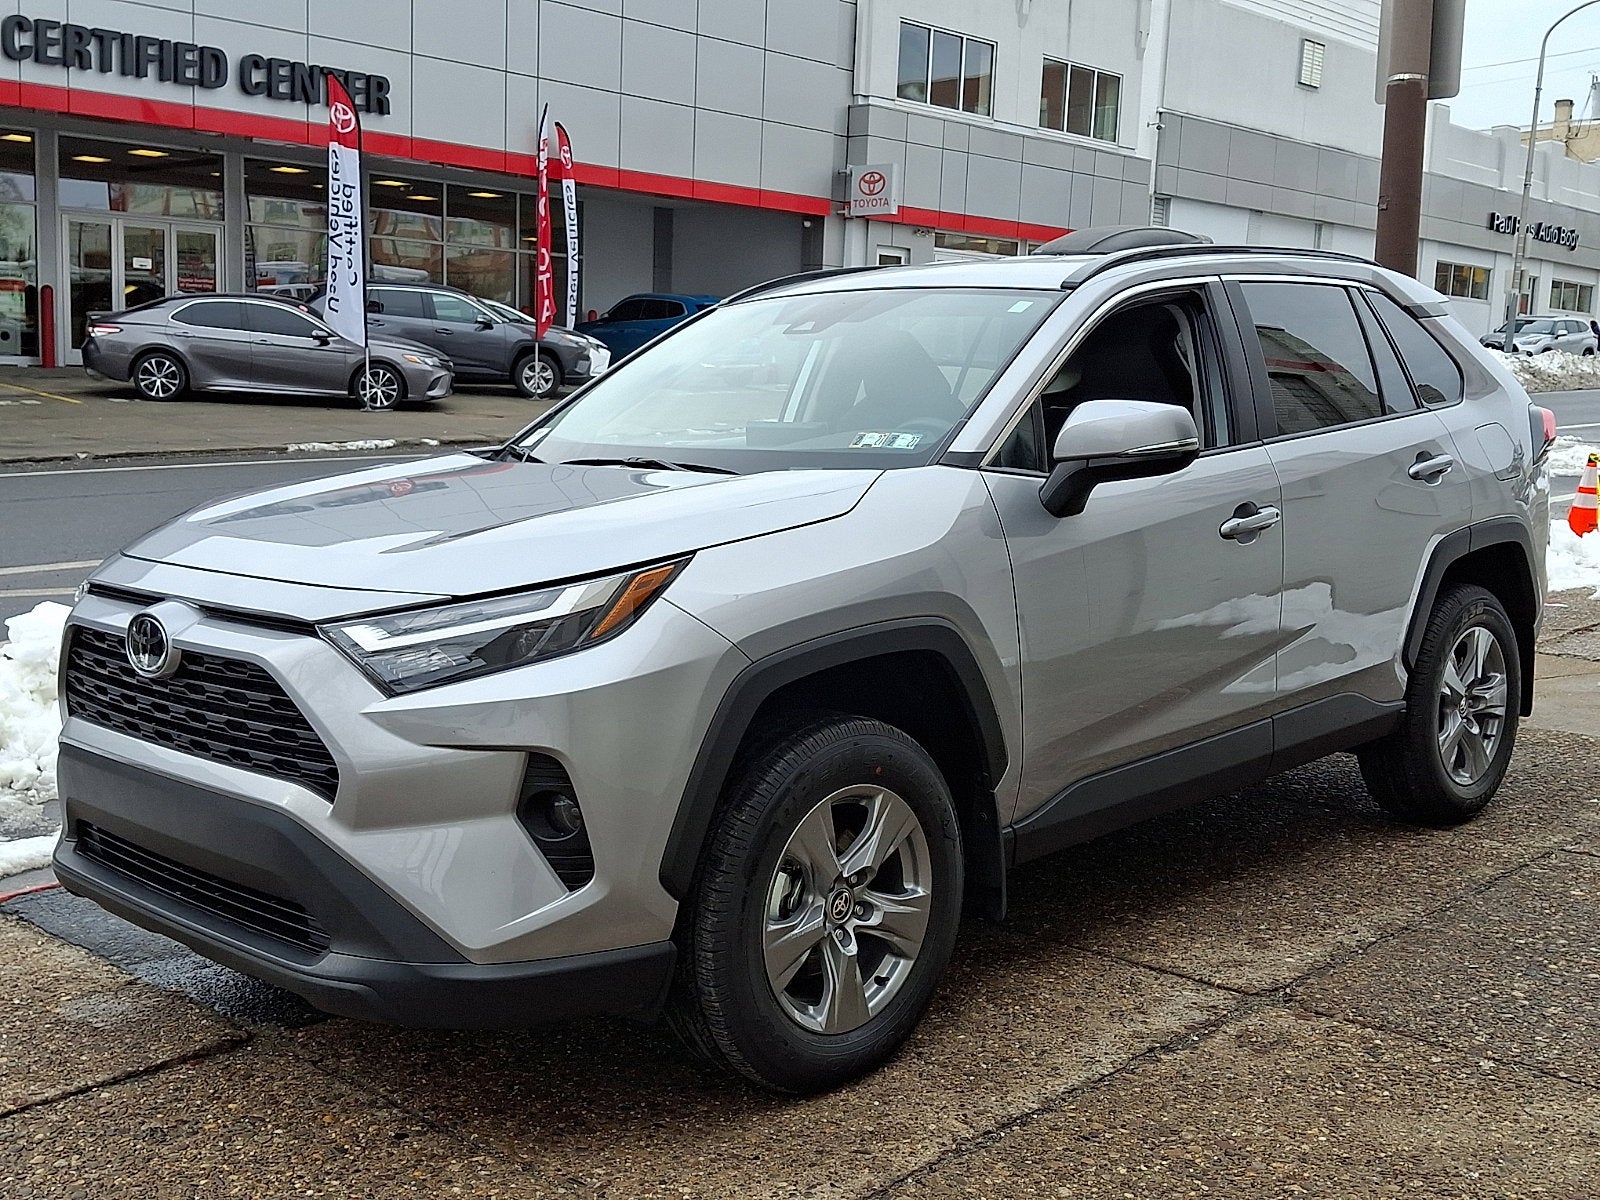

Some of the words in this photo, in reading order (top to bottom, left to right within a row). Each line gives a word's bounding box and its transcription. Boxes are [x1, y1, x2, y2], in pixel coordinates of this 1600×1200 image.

[1, 14, 228, 89] CERTIFIED
[853, 197, 889, 208] TOYOTA
[1489, 211, 1514, 234] Paul
[1536, 221, 1559, 244] Auto
